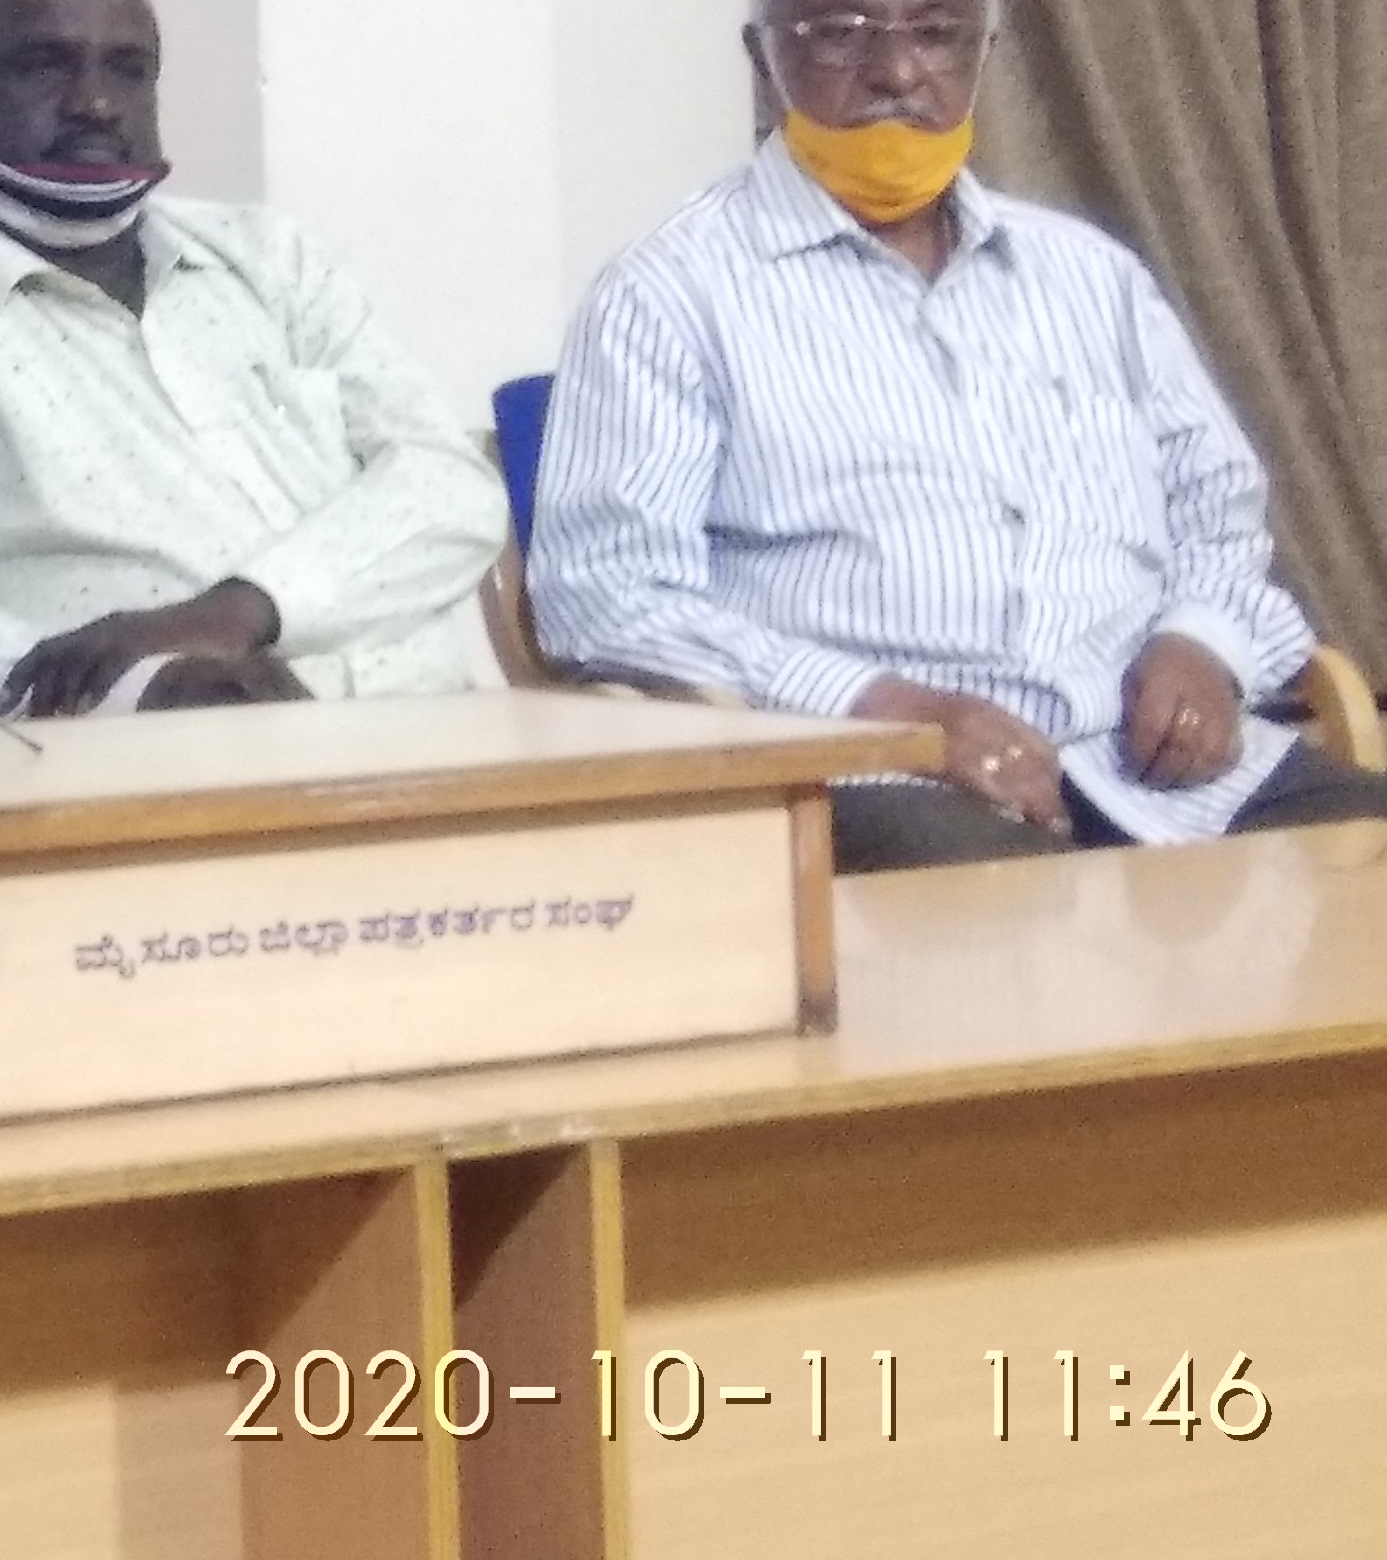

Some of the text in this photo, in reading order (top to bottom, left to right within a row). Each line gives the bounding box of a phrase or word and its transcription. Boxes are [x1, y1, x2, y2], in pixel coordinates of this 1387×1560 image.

[74, 924, 251, 979] ಮೈಸೂರು
[259, 918, 349, 958] ಜಿಲ್ಲಾ
[544, 894, 635, 932] ಸಂಘ
